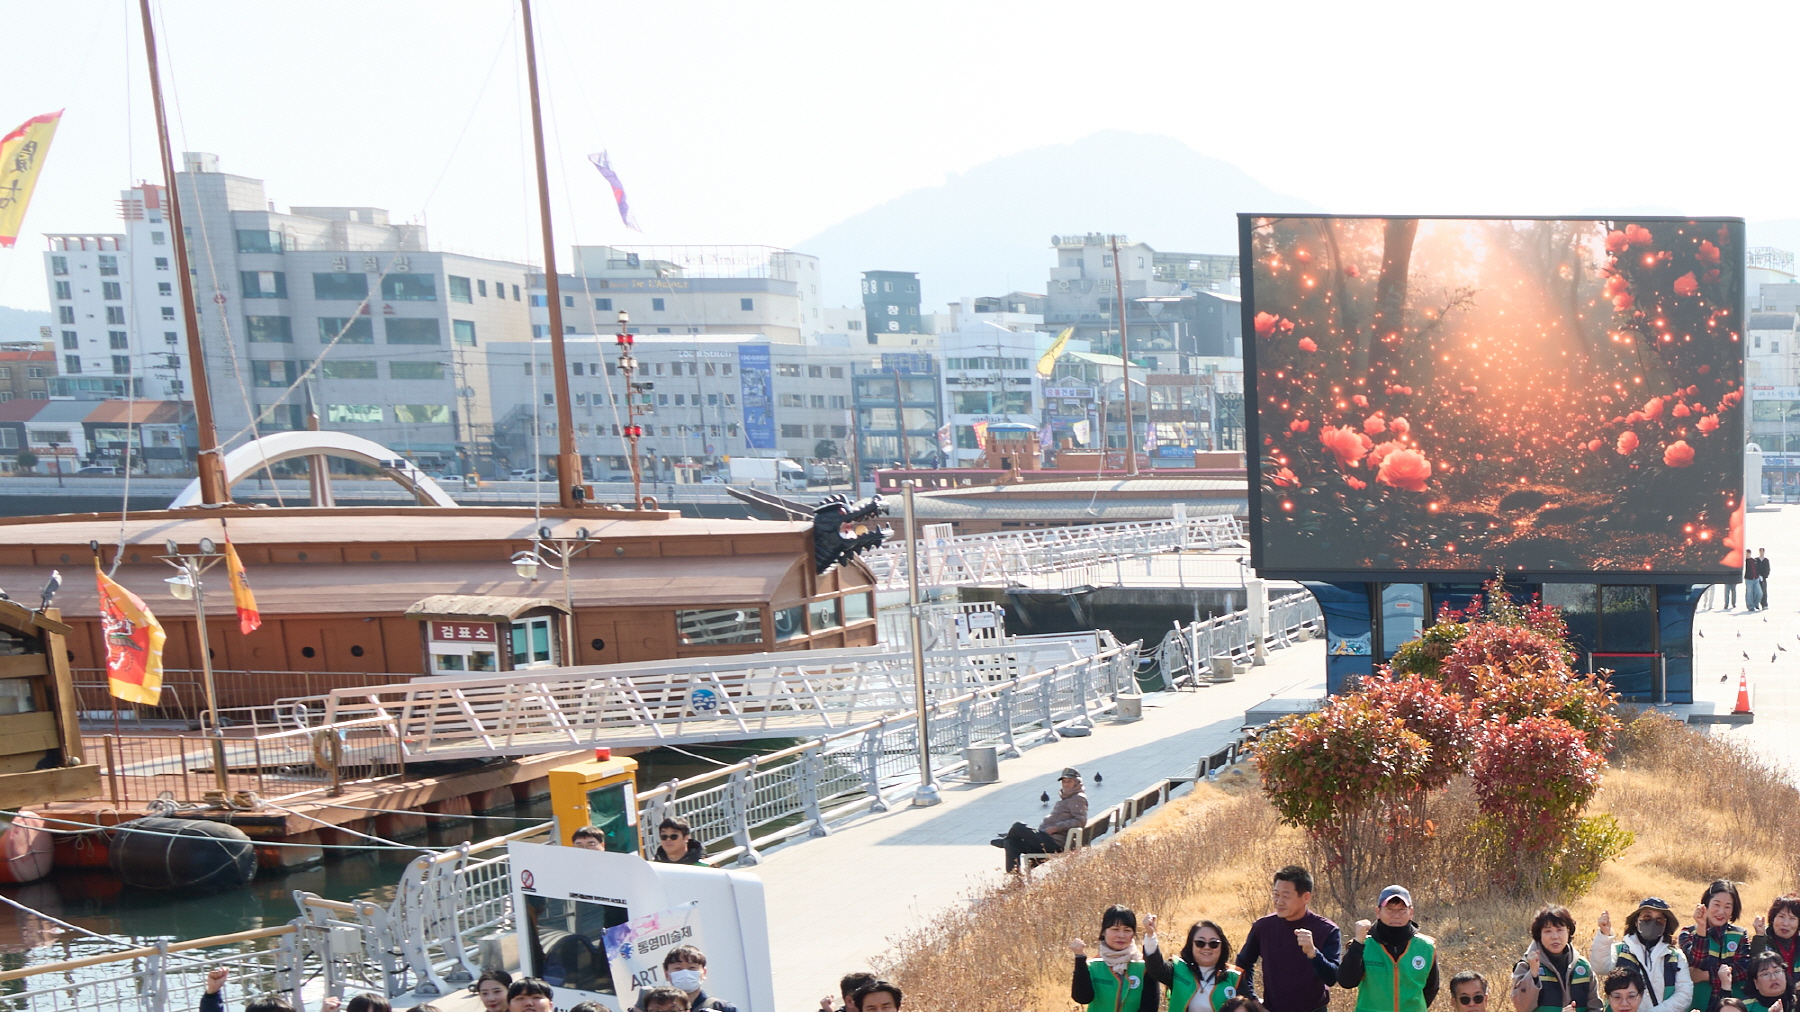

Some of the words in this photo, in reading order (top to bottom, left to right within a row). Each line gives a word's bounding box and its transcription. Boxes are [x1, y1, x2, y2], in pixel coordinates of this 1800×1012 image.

[333, 255, 410, 272] 찜질방
[442, 625, 490, 639] 검표소
[638, 926, 692, 954] 통영미술제
[631, 966, 658, 992] ART
